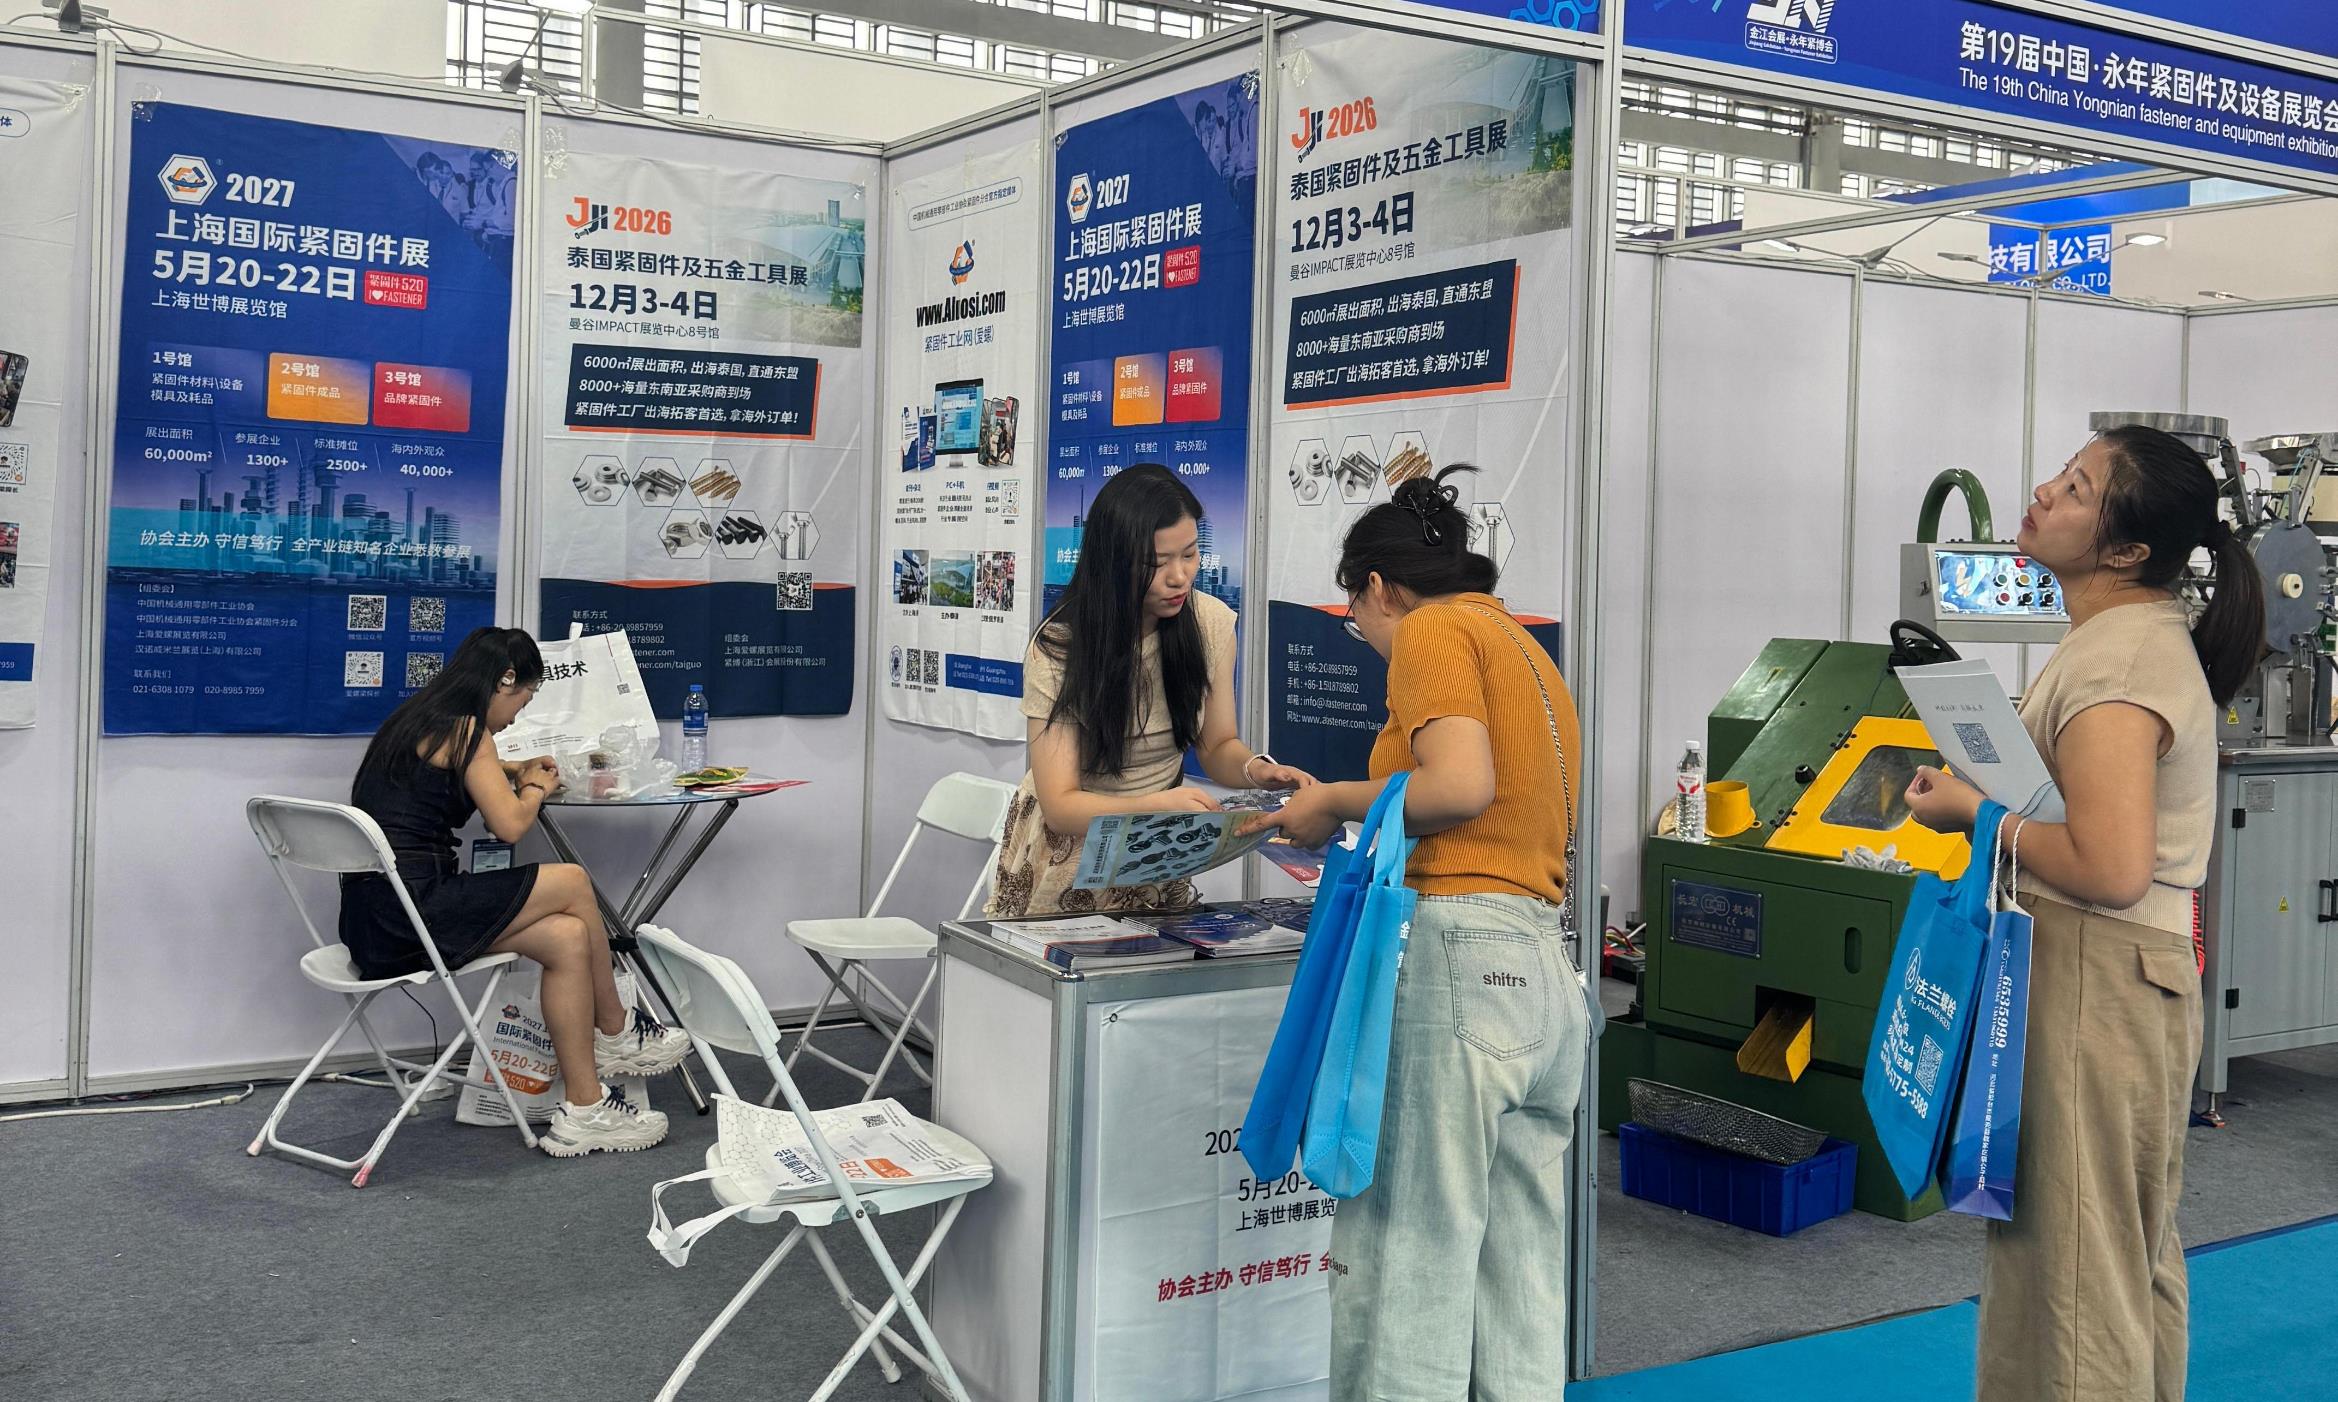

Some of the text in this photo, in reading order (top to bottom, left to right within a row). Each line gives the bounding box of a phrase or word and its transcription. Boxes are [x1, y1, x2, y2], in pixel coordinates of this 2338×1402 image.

[1326, 95, 1377, 141] 2026
[1959, 67, 1987, 91] The
[1993, 75, 2024, 97] 19th
[2028, 81, 2069, 107] China
[2073, 89, 2136, 119] Yongnian
[2140, 103, 2193, 130] fastener
[2195, 118, 2219, 136] and
[2222, 123, 2285, 148] equipment
[1290, 119, 1507, 202] 泰国紧固件及五金工具展
[225, 173, 295, 208] 2027
[1096, 173, 1130, 210] 2027
[613, 205, 672, 236] 2026
[1064, 202, 1202, 262] 上海国际紧固件展
[1291, 191, 1415, 253] 12月3-4日
[156, 209, 430, 268] 上海国际紧固件展
[566, 245, 809, 287] 泰国紧固件及五金工具展
[1289, 241, 1415, 282] 曼谷IMPACT展览中心8号馆
[152, 250, 356, 301] 5月20-22日
[1063, 253, 1161, 302] 5月20-22日
[151, 289, 288, 319] 上海世博展览馆
[384, 290, 423, 305] FASTENER
[569, 282, 718, 321] 12月3-4日
[1062, 302, 1125, 329] 上海世博展览馆
[568, 317, 720, 340] 曼谷IMPACT展览中心8号馆
[1296, 320, 1445, 358] 8000+海量东南亚采购商到场
[152, 351, 193, 367] 1号馆
[280, 362, 320, 378] 2号馆
[1174, 358, 1194, 374] 3号馆
[384, 371, 422, 387] 3号馆
[1062, 371, 1080, 385] 1号馆
[1120, 364, 1139, 379] 2号馆
[280, 382, 341, 399] 紧固件成品
[384, 391, 443, 408] 品牌紧固件
[578, 378, 752, 401] 8000+海量东南亚采购商到场
[145, 425, 193, 441] 展出面积
[234, 431, 281, 446] 参展企业
[314, 438, 358, 452] 标准摊位
[391, 442, 446, 458] 海内外观众
[246, 453, 289, 467] 1300+
[326, 458, 369, 473] 2500+
[399, 463, 454, 478] 40,000+
[1178, 462, 1210, 477] 40,000+
[139, 529, 210, 548] 协会主办
[214, 532, 284, 552] 守信笃行
[572, 610, 608, 620] 联系方式
[174, 686, 195, 694] 1079
[245, 687, 265, 695] 7959
[1482, 971, 1527, 987] shitrs
[496, 1021, 554, 1051] 国际紧固件
[1205, 1128, 1243, 1156] 202
[1236, 1197, 1337, 1232] 上海世博展览
[1158, 1267, 1234, 1303] 协会主办
[1239, 1253, 1312, 1287] 守信笃行
